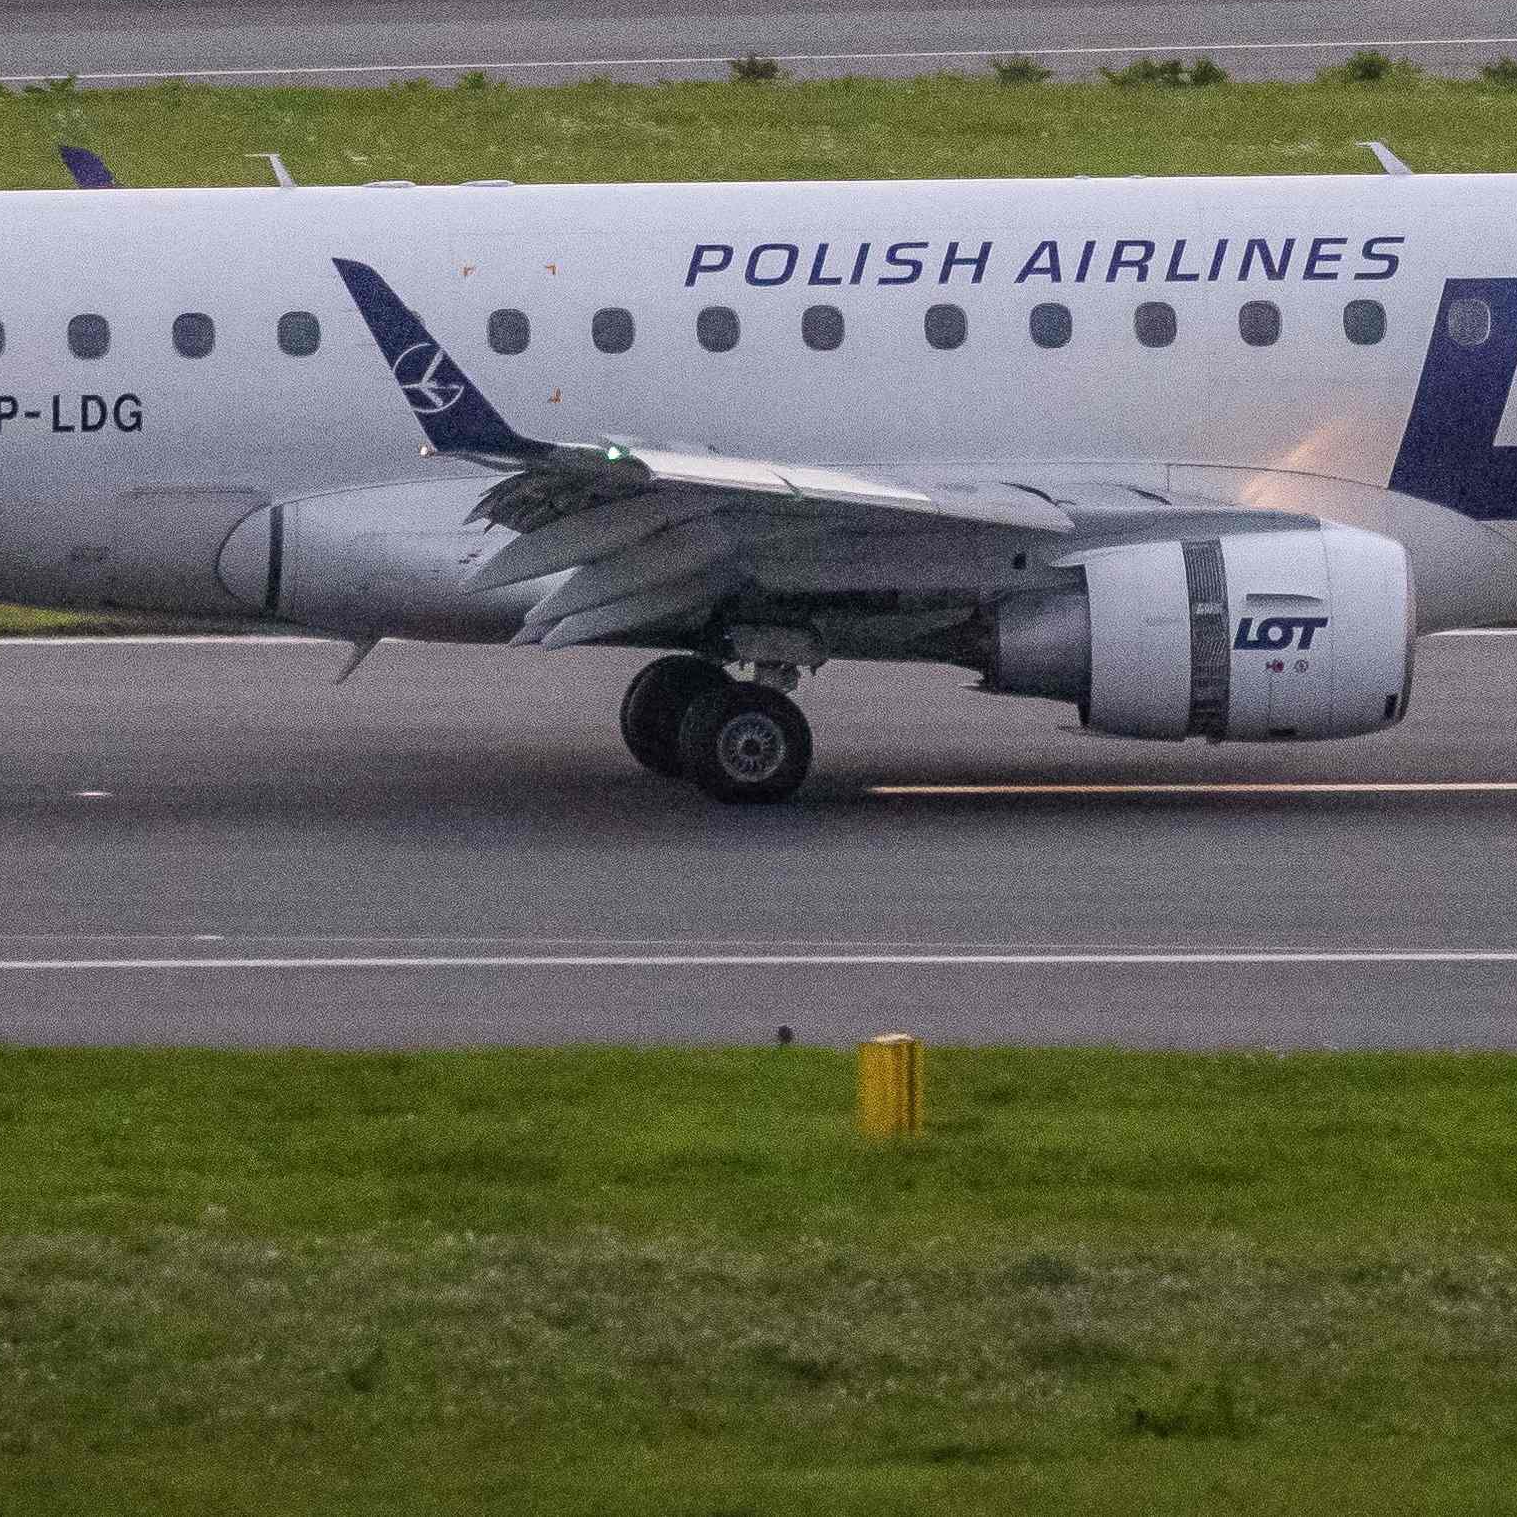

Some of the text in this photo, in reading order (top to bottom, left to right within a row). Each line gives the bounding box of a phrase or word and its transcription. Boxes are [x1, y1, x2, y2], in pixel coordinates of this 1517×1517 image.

[685, 236, 1405, 287] POLISH AIRLINES
[1233, 616, 1329, 651] LOT
